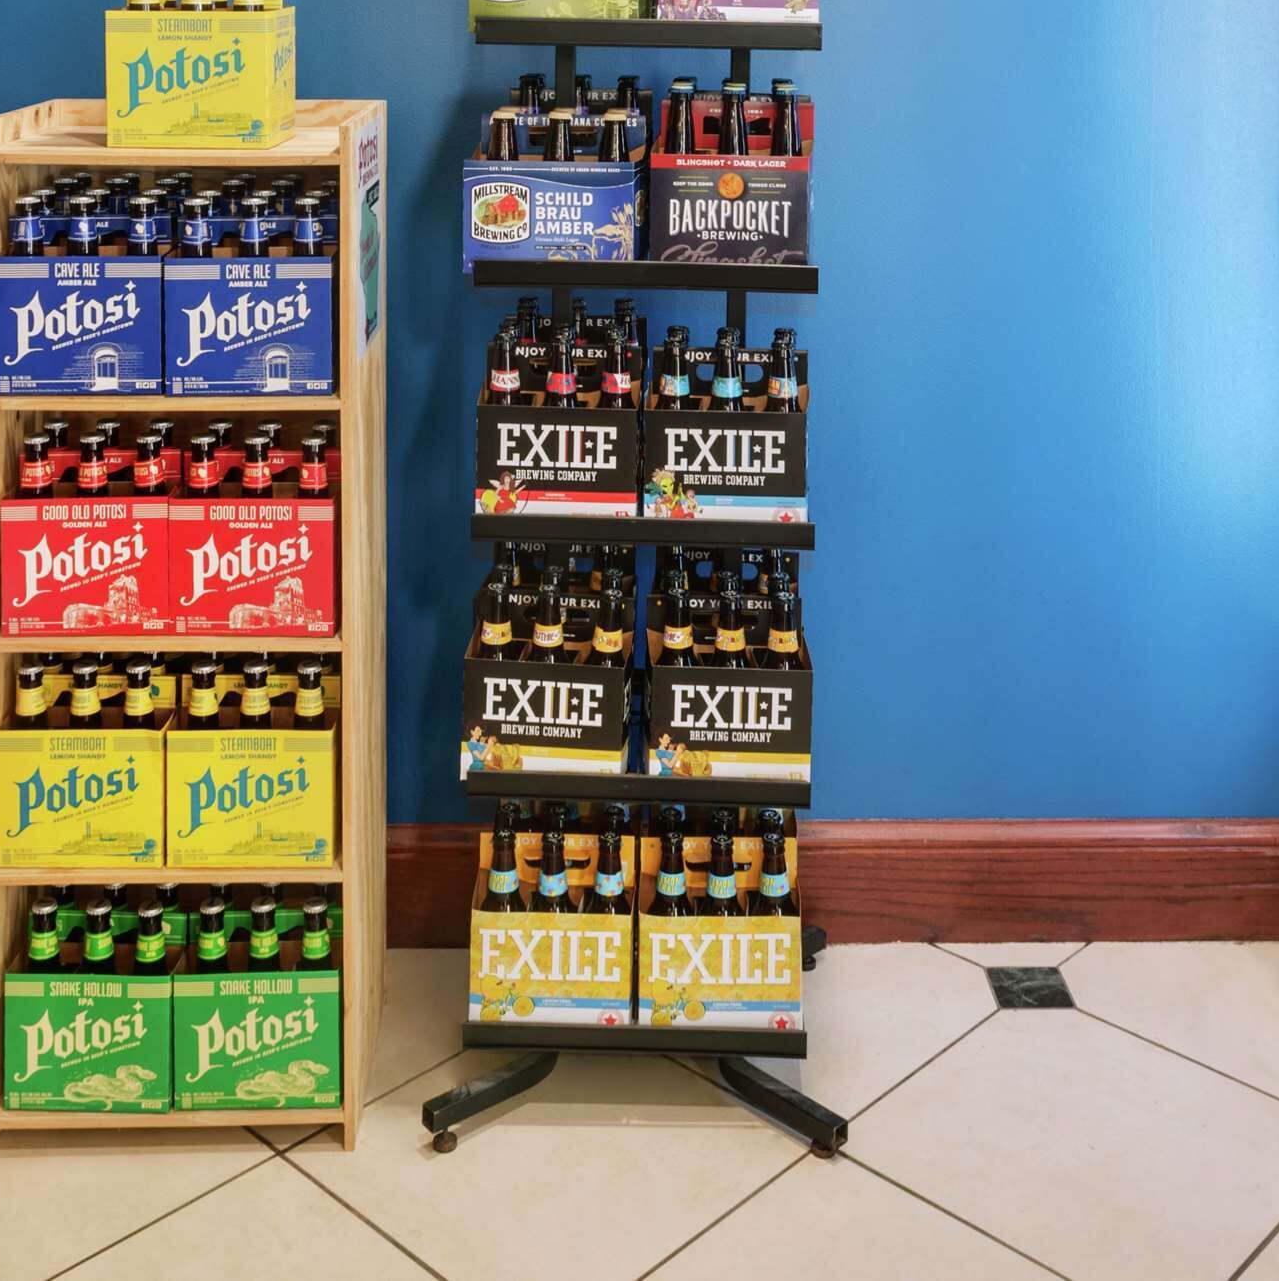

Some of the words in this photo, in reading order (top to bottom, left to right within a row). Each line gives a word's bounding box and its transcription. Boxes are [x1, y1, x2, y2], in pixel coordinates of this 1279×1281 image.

[157, 18, 212, 32] STEAMBOAT
[116, 37, 245, 118] Potosi
[759, 160, 787, 168] LAGER
[474, 185, 528, 204] MILLSTREAM
[535, 192, 593, 206] SCHILD
[536, 207, 581, 220] BRAU
[670, 198, 791, 238] BACKPOCKET
[474, 223, 515, 241] BREWING
[535, 222, 594, 235] AMBER
[701, 231, 759, 241] BREWING
[55, 263, 79, 278] CAVE
[83, 263, 100, 278] ALE
[226, 264, 251, 279] CAVE
[254, 264, 271, 279] ALE
[228, 280, 253, 288] AMBER
[255, 280, 268, 288] ALE
[4, 280, 141, 366] Potosi
[176, 281, 311, 367] Potosi
[515, 347, 547, 357] NJOY
[497, 423, 617, 469] EXILE
[664, 428, 785, 474] EXILE
[516, 469, 555, 480] BREWING
[557, 470, 597, 482] COMPANY
[683, 475, 722, 485] BREWING
[726, 475, 766, 486] COMPANY
[42, 505, 68, 520] GOOD
[72, 505, 90, 519] OLD
[93, 504, 126, 519] POTOSI
[210, 506, 237, 521] GOOD
[240, 506, 257, 521] OLD
[259, 506, 293, 521] POTOSI
[12, 522, 148, 607] Potosi
[179, 524, 313, 607] Potosi
[509, 594, 538, 605] NJOY
[483, 677, 603, 727] EXILE
[670, 684, 792, 731] EXILE
[501, 724, 540, 735] BREWING
[542, 725, 582, 738] COMPANY
[690, 730, 729, 741] BREWING
[732, 731, 772, 743] COMPANY
[49, 737, 106, 751] STEAMBOAT
[220, 737, 277, 751] STEAMBOAT
[6, 756, 139, 839] Potosi
[177, 756, 310, 839] Potosi
[478, 929, 621, 982] EXILE
[648, 933, 791, 984] EXILE
[50, 982, 81, 996] SNAKE
[84, 983, 122, 998] HOLLOW
[220, 980, 250, 995] SNAKE
[253, 979, 293, 994] HOLLOW
[78, 998, 94, 1006] IPA
[248, 996, 264, 1004] IPA
[14, 1001, 147, 1083] Potosi
[185, 996, 319, 1082] Potosi
